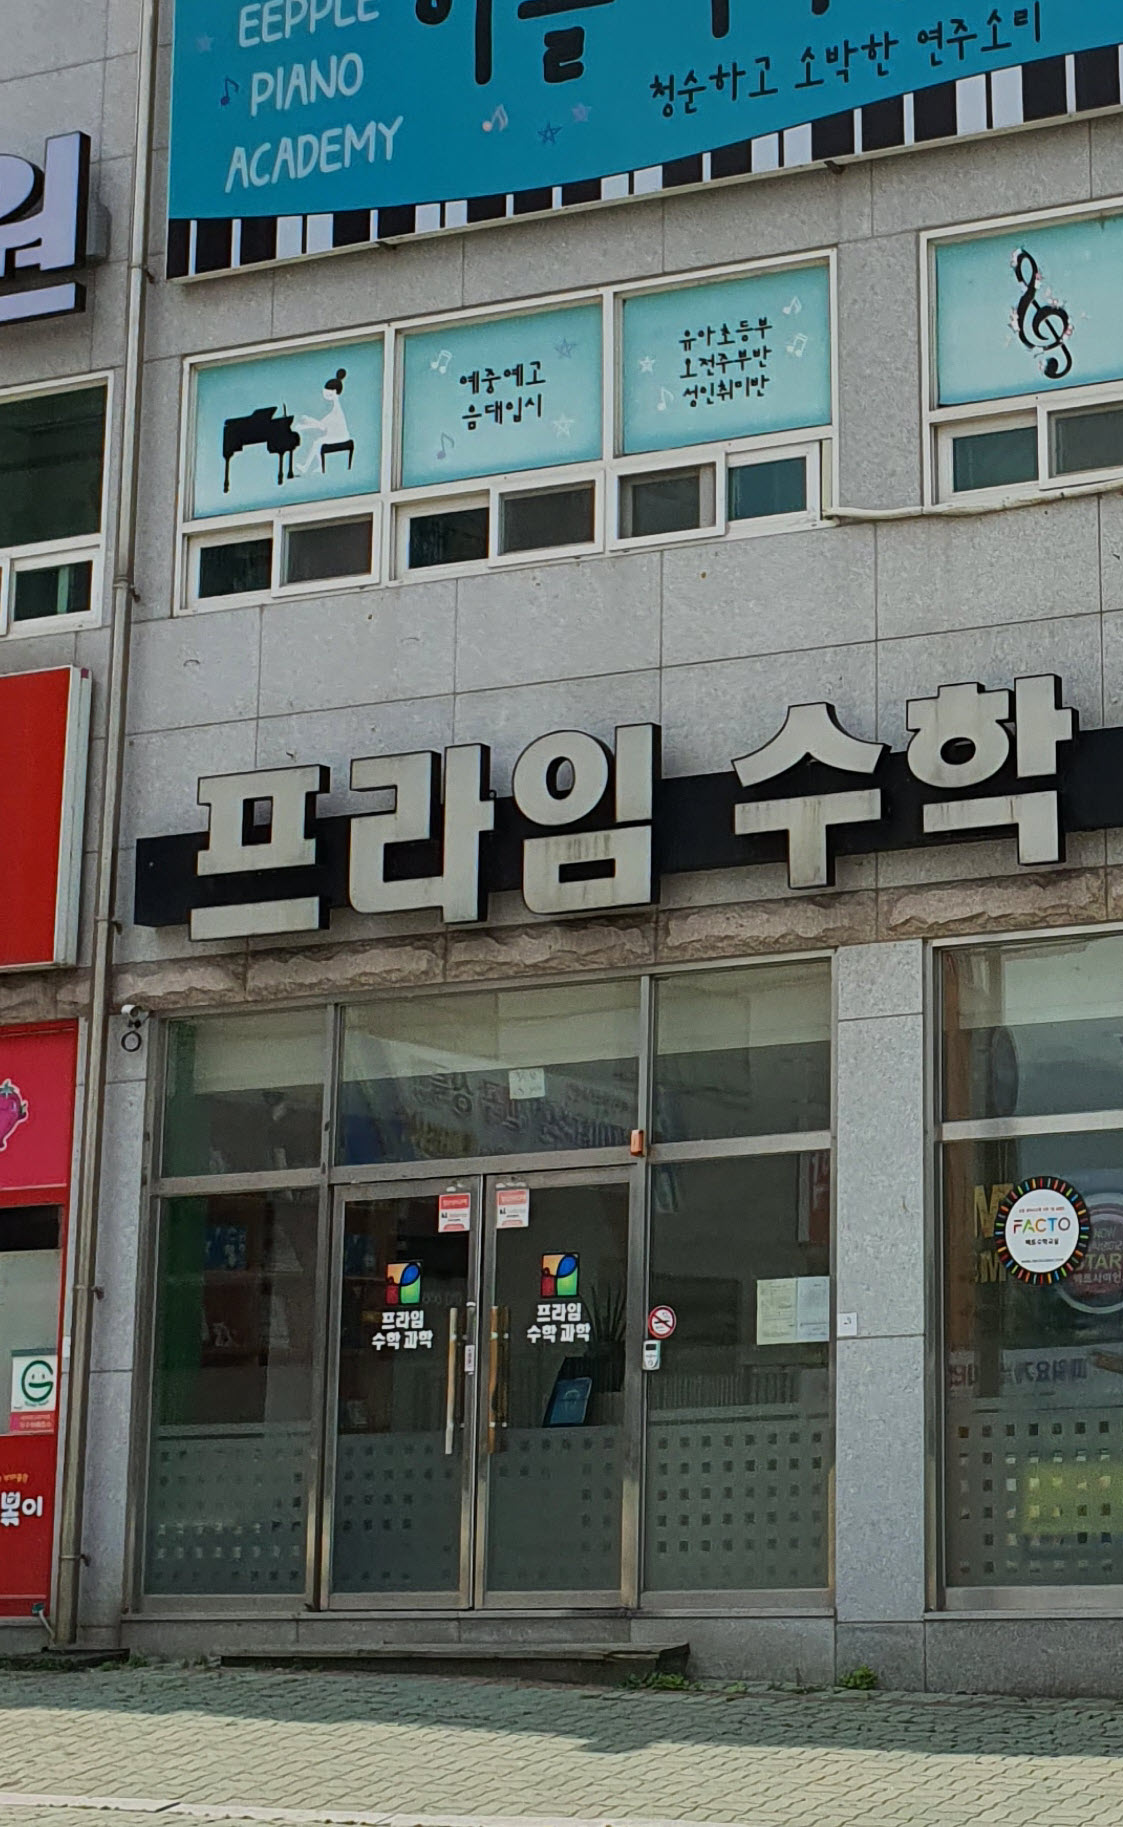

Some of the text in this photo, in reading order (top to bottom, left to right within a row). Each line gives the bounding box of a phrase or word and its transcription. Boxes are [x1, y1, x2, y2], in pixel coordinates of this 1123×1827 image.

[650, 1, 1041, 118] 청순하고 소박한 연주소리
[250, 52, 364, 117] PIANO
[224, 115, 404, 194] ACADEMY
[679, 316, 773, 352] 유아초등부
[459, 360, 546, 394] 예중예고
[680, 345, 772, 378] 오전주부반
[683, 375, 770, 407] 성인취미반
[461, 393, 542, 430] 음대입시
[190, 723, 662, 942] 프라임
[731, 672, 1080, 890] 수학
[1013, 1216, 1071, 1235] FACTO
[381, 1310, 425, 1330] 프라임
[536, 1302, 583, 1322] 프라임
[371, 1329, 433, 1350] 수학 과학
[526, 1323, 591, 1344] 수학 과학
